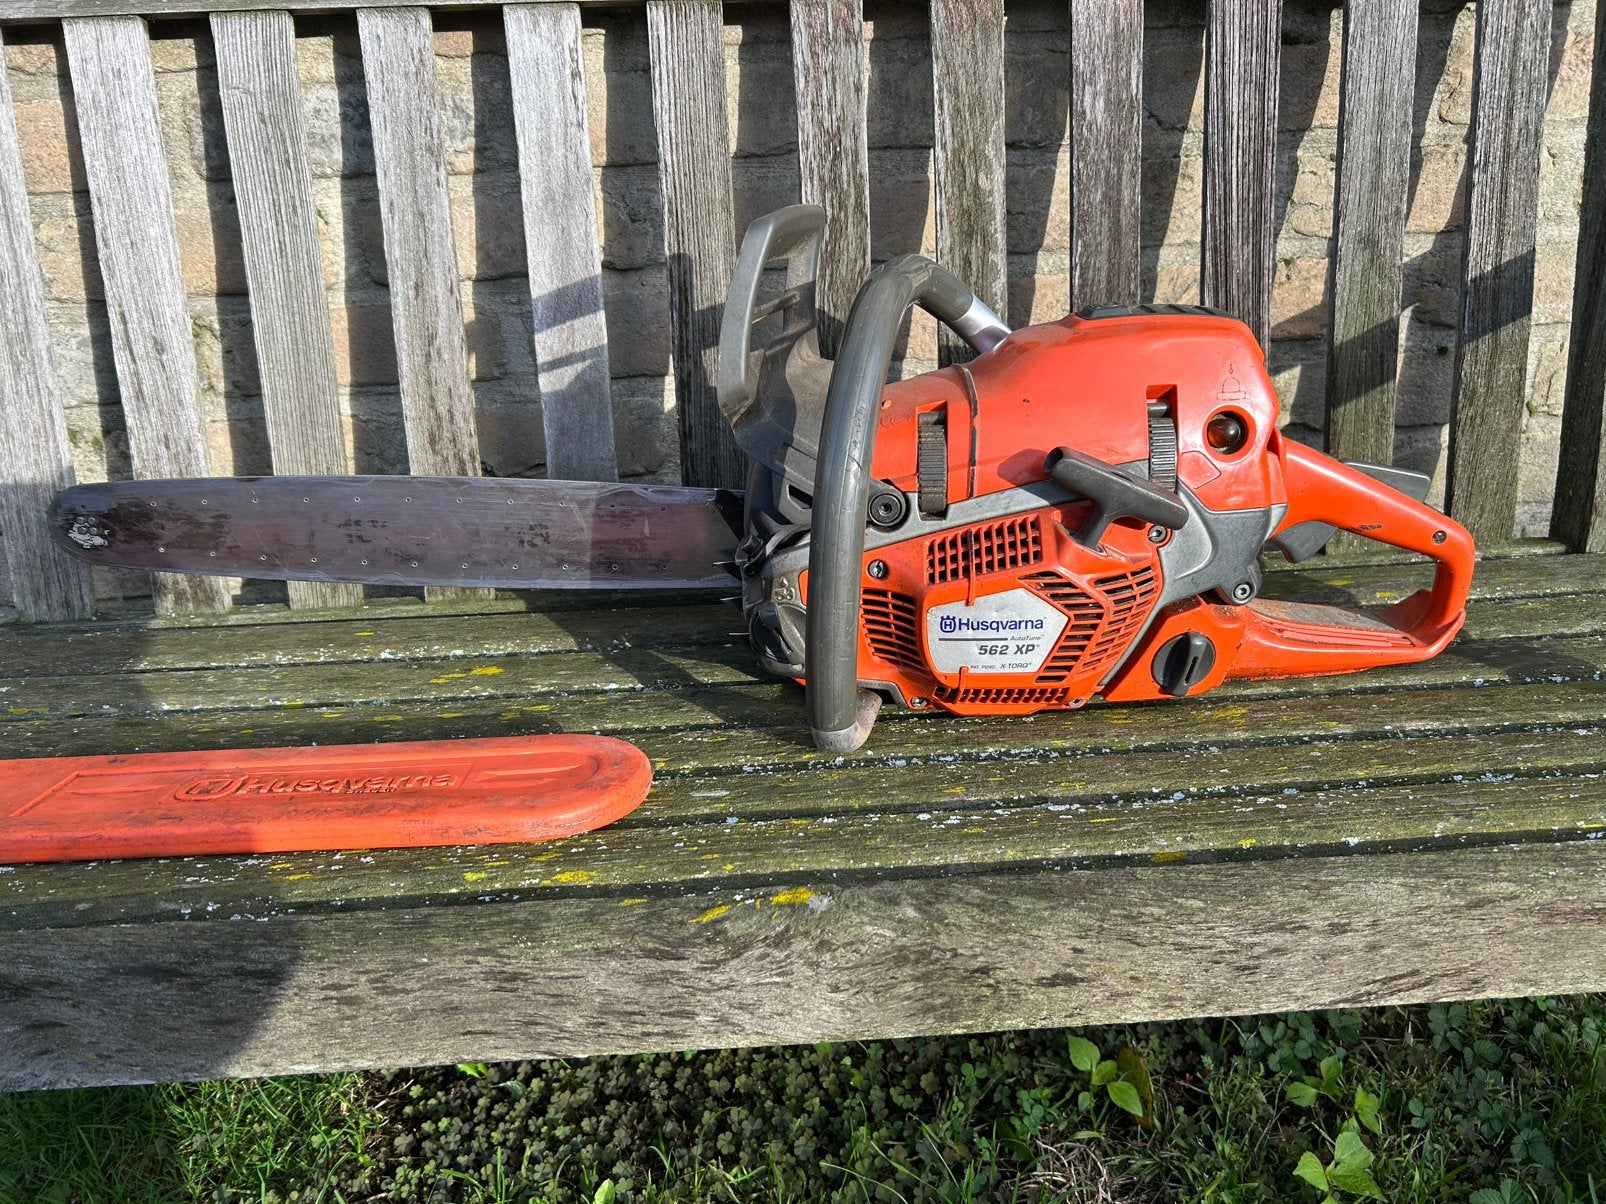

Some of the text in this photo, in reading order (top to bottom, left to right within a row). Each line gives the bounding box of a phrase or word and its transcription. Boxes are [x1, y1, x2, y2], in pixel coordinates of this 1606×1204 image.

[958, 617, 1044, 632] Husqvarna
[978, 644, 1035, 656] 562 XP
[236, 773, 460, 795] Husqvarna
